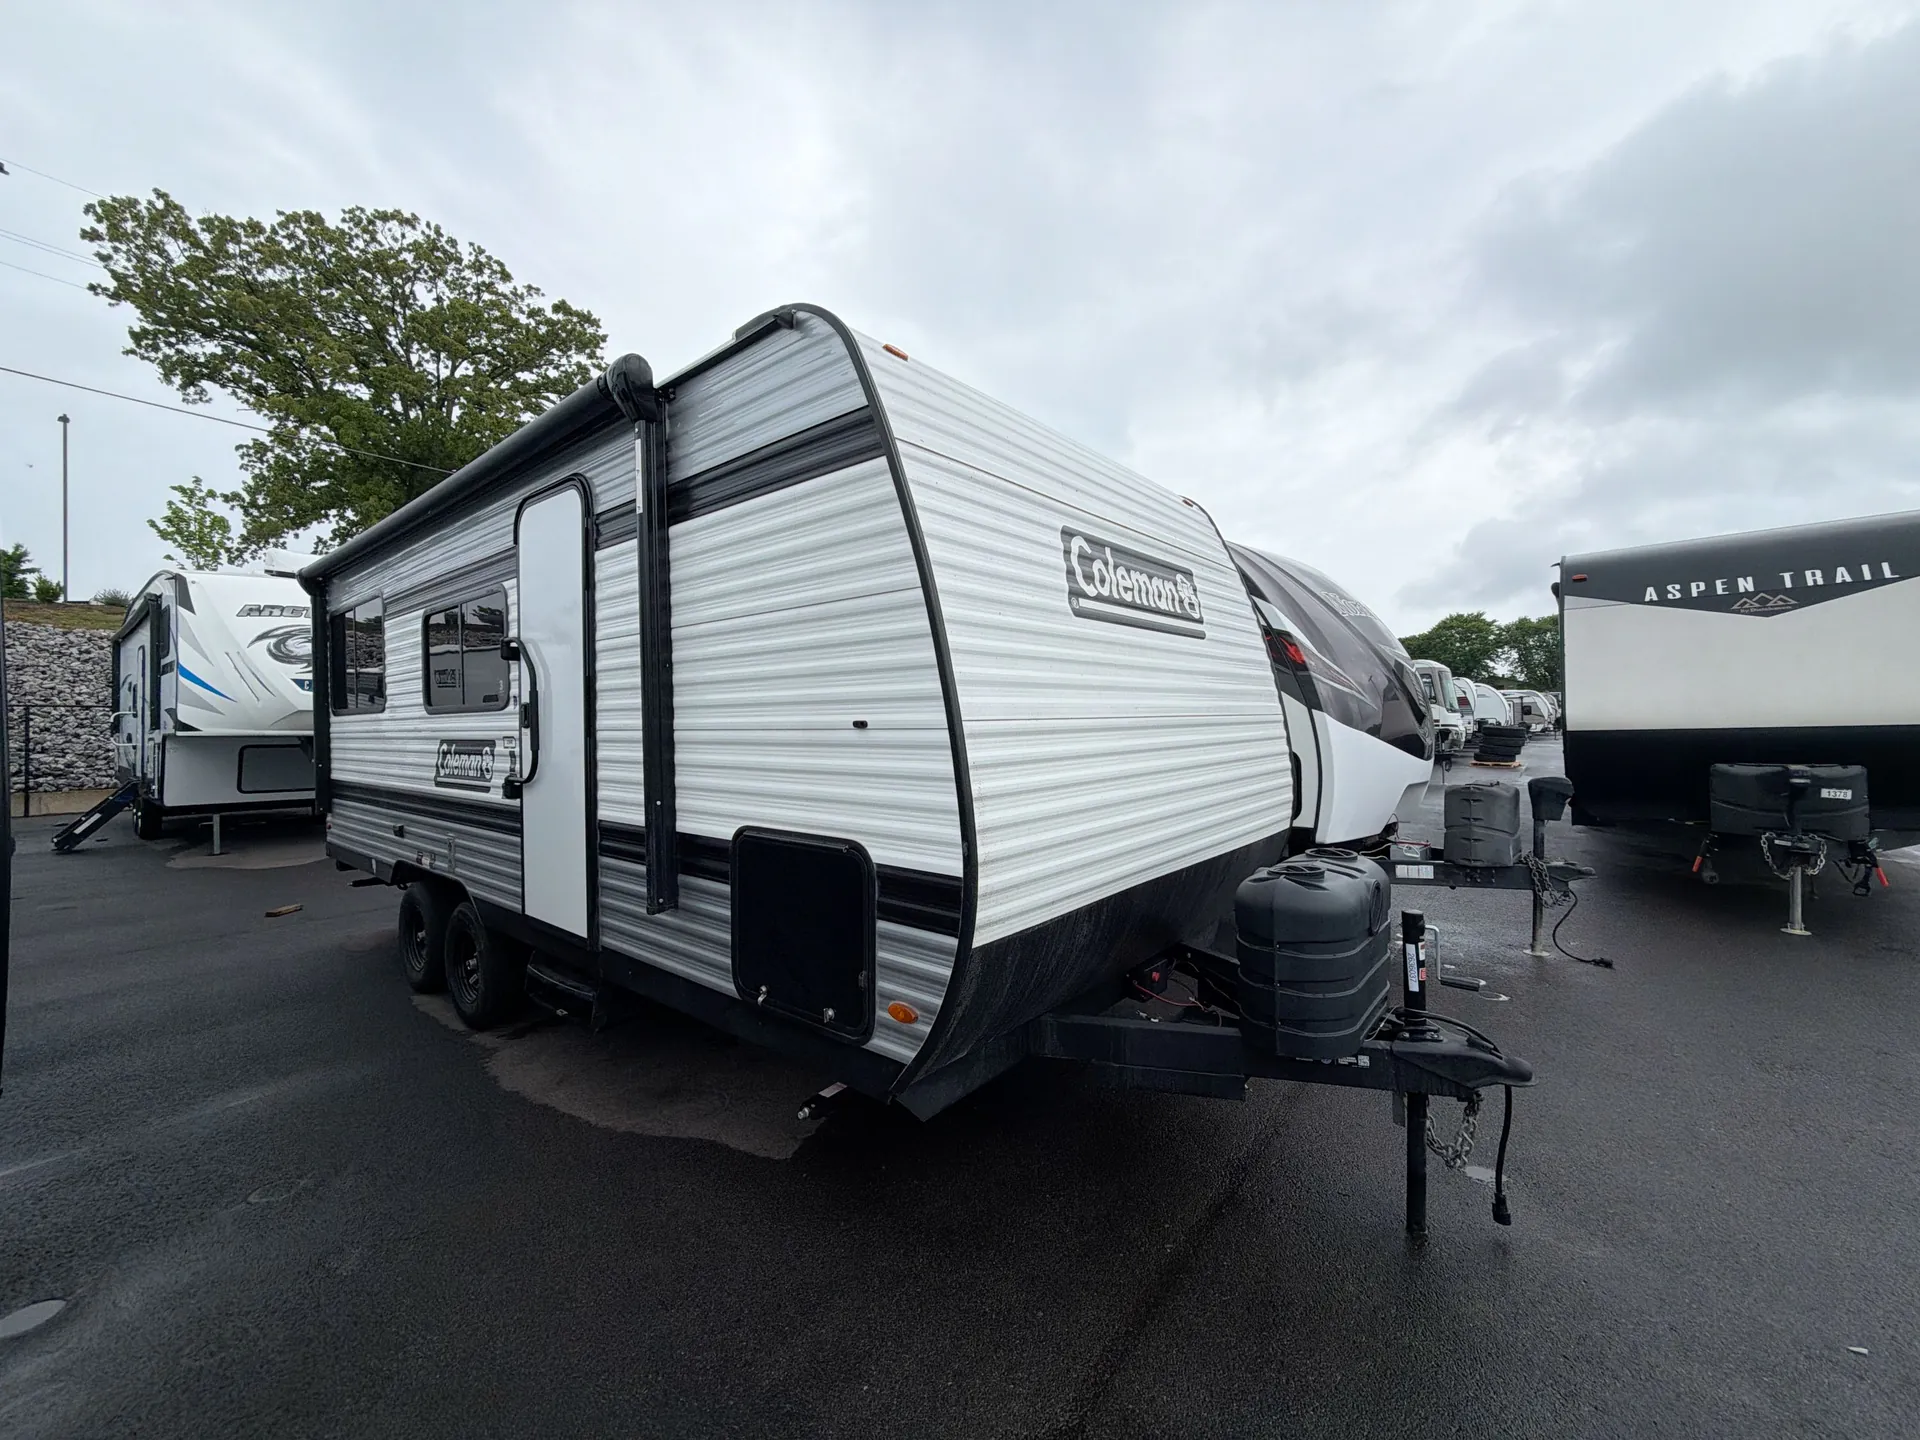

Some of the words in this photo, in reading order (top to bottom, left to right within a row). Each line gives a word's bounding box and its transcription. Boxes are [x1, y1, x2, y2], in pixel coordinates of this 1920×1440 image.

[1070, 535, 1182, 614] Coleman
[1644, 576, 1755, 602] ASPEN
[1779, 561, 1900, 589] TRAIL
[438, 742, 482, 777] Coleman
[1827, 790, 1848, 798] 1378
